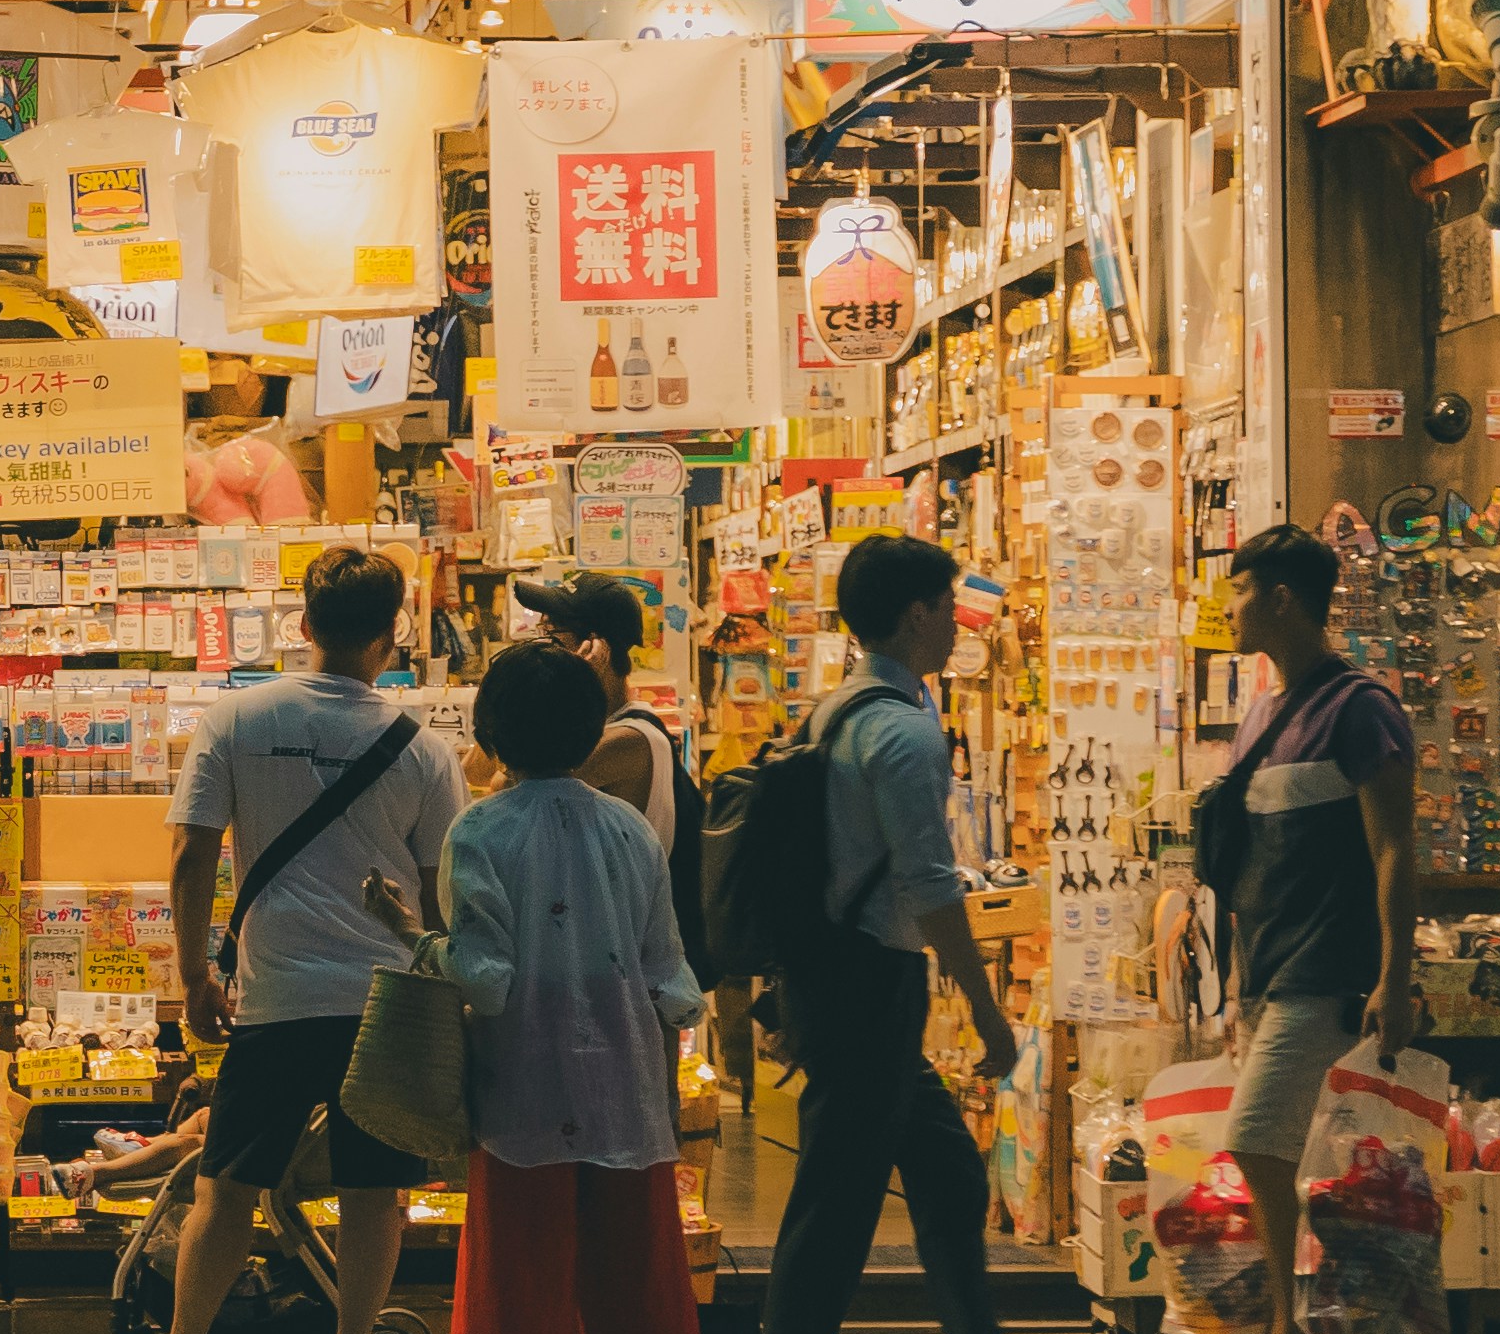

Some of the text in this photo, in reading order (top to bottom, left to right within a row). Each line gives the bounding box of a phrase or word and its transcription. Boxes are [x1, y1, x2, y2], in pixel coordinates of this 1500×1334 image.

[531, 79, 592, 95] 詳しくは
[295, 116, 375, 136] BLUE SEAL
[77, 168, 141, 193] SPAM
[358, 168, 392, 177] CREAM
[572, 161, 700, 224] 送料
[96, 234, 142, 247] okinawa
[132, 243, 169, 257] SPAM
[358, 248, 409, 260] ブルーシール
[573, 227, 701, 286] 無料
[582, 304, 699, 316] 期間限定キャンペーン中
[819, 300, 903, 331] できます
[38, 434, 150, 456] available!
[204, 612, 219, 656] Orion
[36, 906, 94, 923] じゃがりこ
[127, 906, 173, 923] じゃがり
[105, 977, 134, 992] 997
[92, 1086, 117, 1097] 5500
